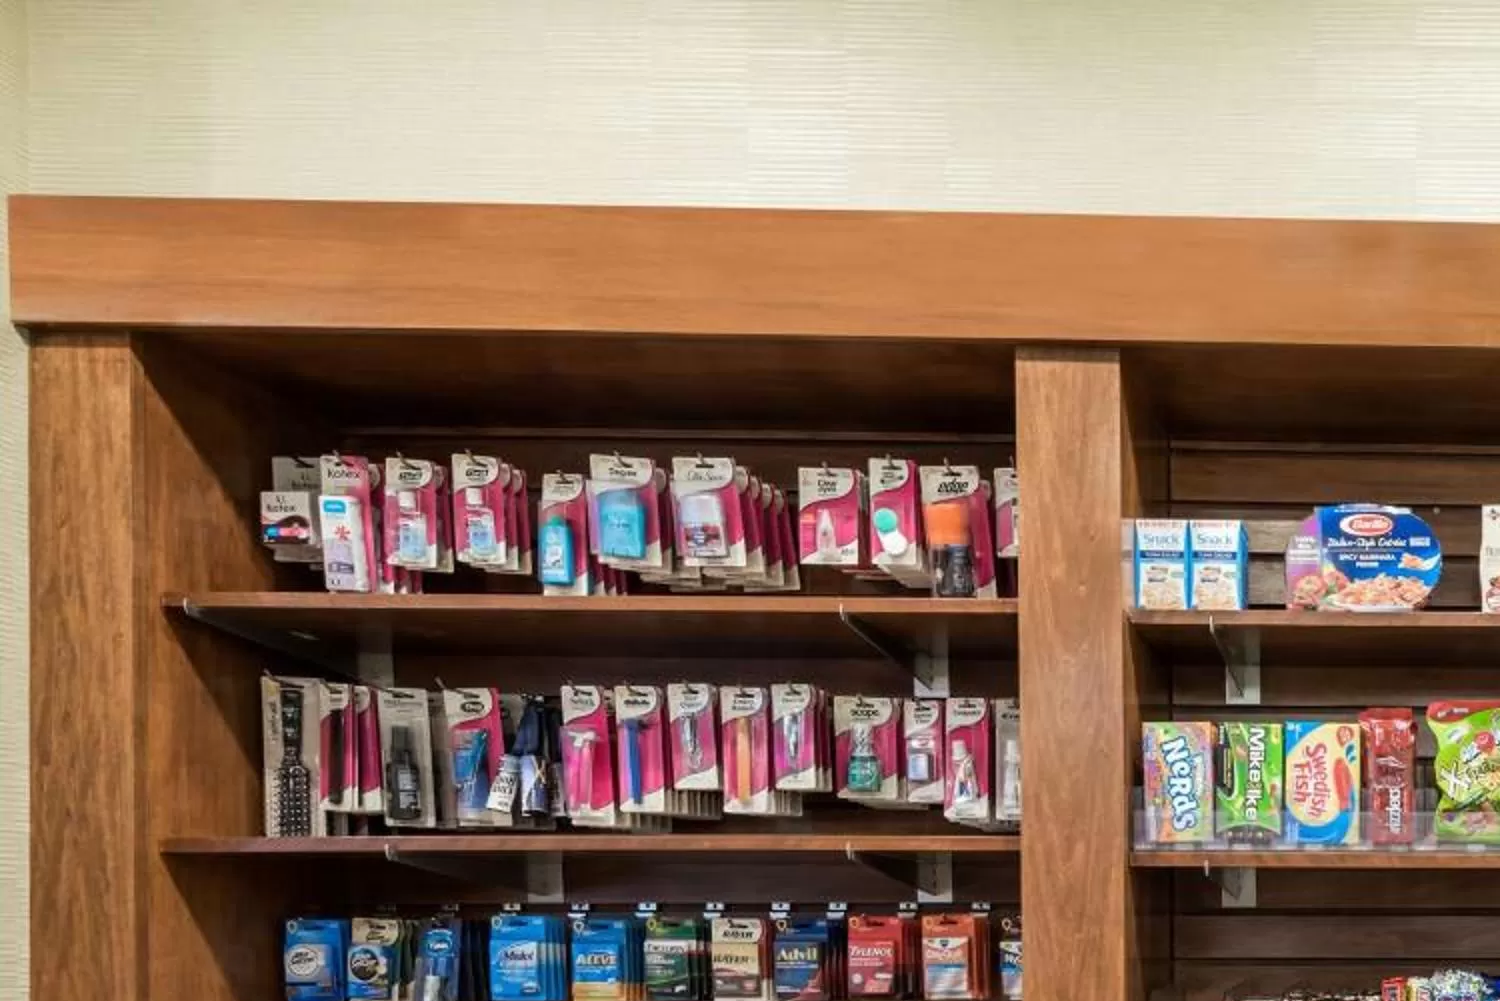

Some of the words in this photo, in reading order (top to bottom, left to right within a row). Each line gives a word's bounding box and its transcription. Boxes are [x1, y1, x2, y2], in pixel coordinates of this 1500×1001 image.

[327, 468, 361, 480] Kotex
[1292, 761, 1311, 804] Fish
[1305, 742, 1330, 819] Swedish
[776, 947, 818, 962] Advil
